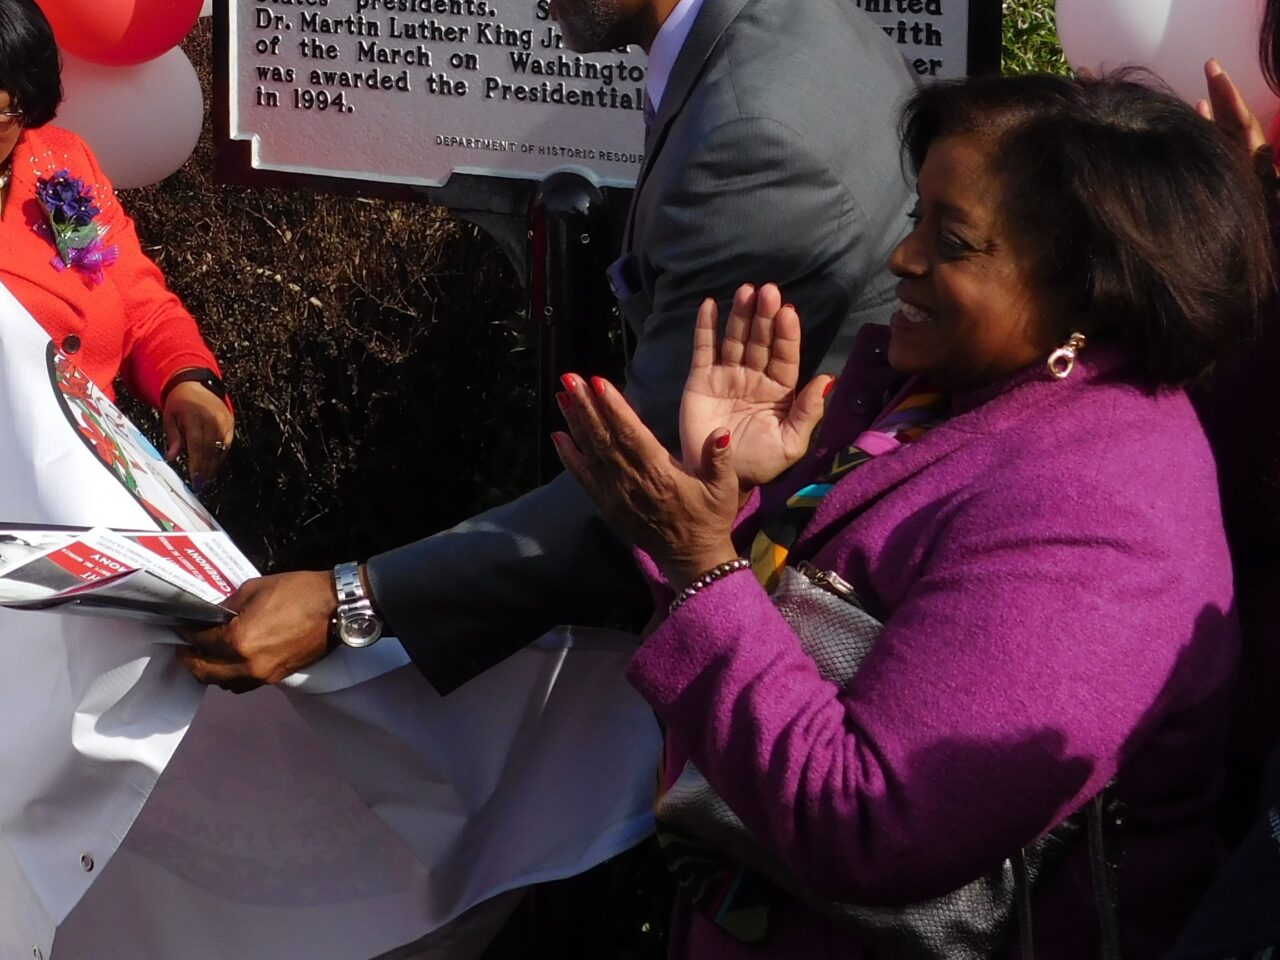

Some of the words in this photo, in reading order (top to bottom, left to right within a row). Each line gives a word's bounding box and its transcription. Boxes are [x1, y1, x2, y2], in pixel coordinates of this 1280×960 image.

[255, 8, 292, 30] Dr.
[300, 11, 380, 37] Martin
[389, 16, 469, 42] Luther
[477, 23, 534, 50] King
[255, 36, 280, 55] of
[299, 39, 339, 59] the
[357, 42, 432, 68] March
[450, 52, 479, 70] on
[509, 51, 645, 85] Washingto
[255, 65, 295, 83] was
[310, 68, 411, 92] awarded
[427, 74, 468, 96] the
[485, 77, 643, 111] Presidential
[255, 86, 279, 107] in
[294, 88, 355, 114] 1994.
[435, 135, 517, 153] DEPARTMENT
[521, 144, 535, 154] OF
[538, 146, 596, 160] HISTORIC
[599, 150, 644, 164] RESOUR
[184, 548, 232, 593] CEREMONY
